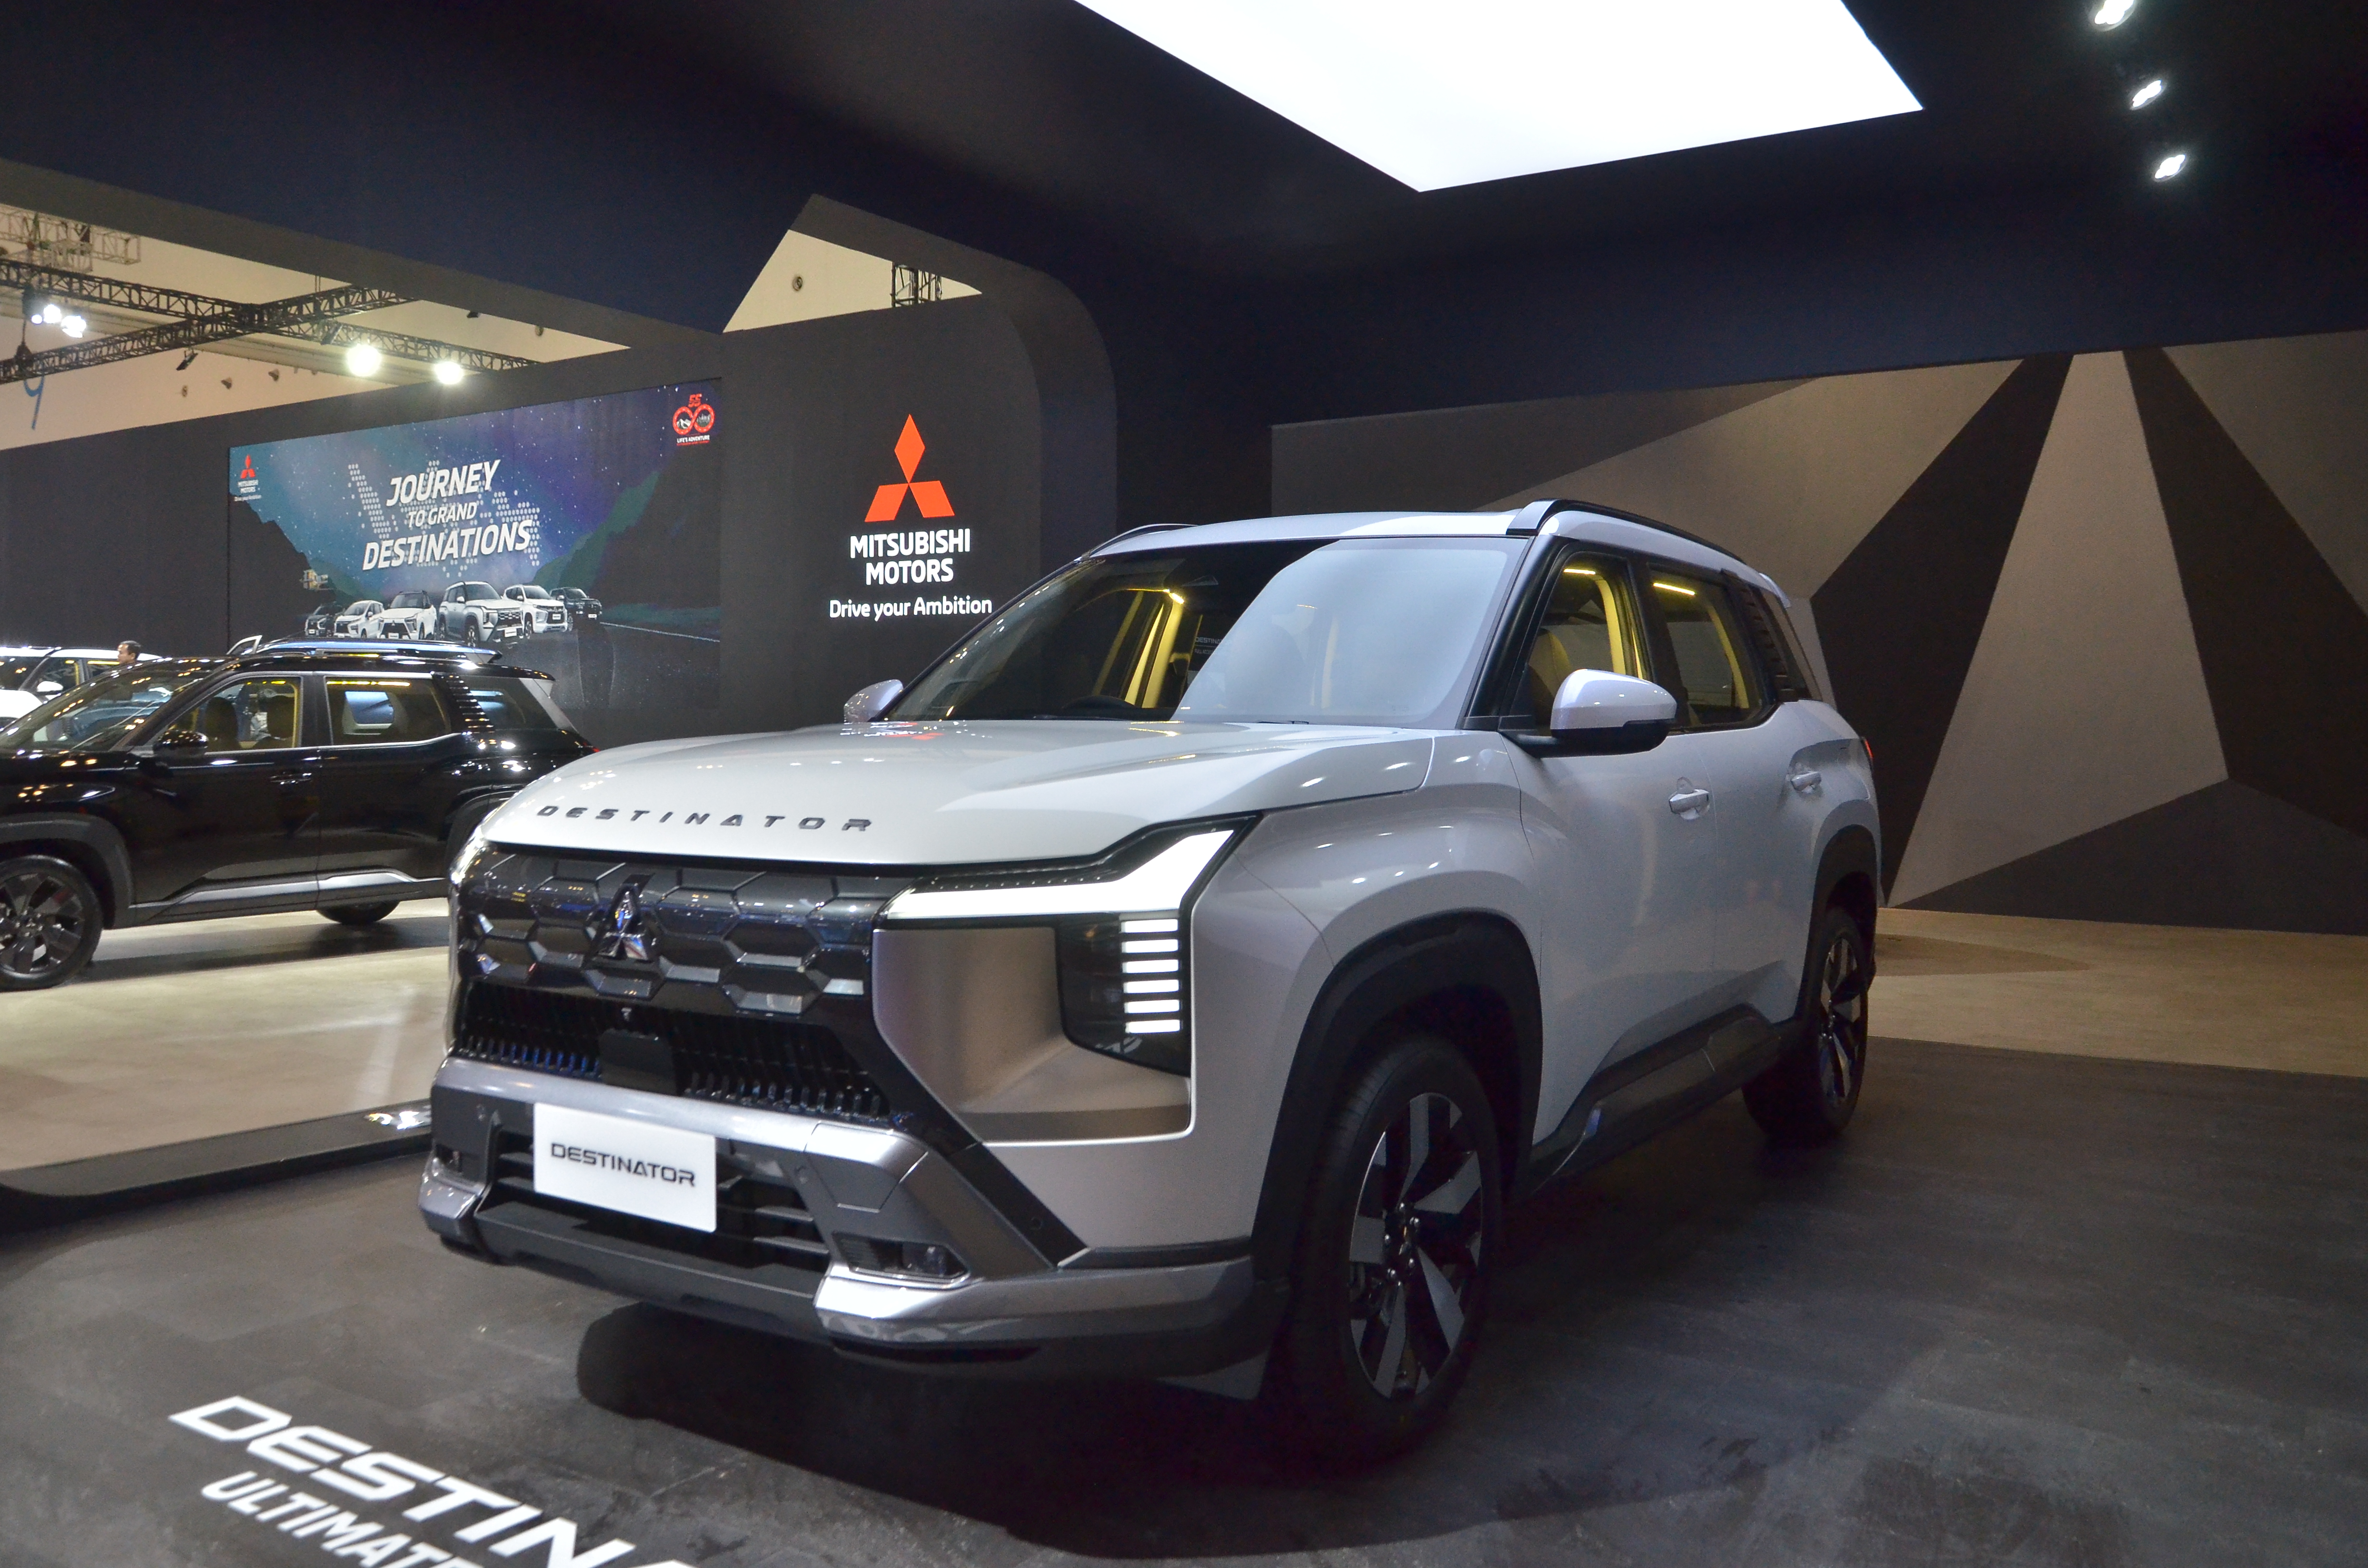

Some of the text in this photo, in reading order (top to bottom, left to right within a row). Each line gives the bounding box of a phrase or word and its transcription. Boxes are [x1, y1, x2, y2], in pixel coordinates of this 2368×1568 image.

[688, 393, 702, 407] 55
[386, 459, 501, 506] JOURNEY
[408, 502, 478, 528] TO GRAND
[363, 519, 533, 571] DESTINATIONS
[850, 528, 971, 559] MITSUBISHI
[866, 558, 954, 585] MOTORS
[829, 595, 992, 622] Drive your Ambition
[537, 805, 872, 832] DESTINATOR
[551, 1143, 696, 1187] DESTINATOR
[168, 1395, 697, 1568] DESTIN
[201, 1470, 483, 1568] ULTIMAT
